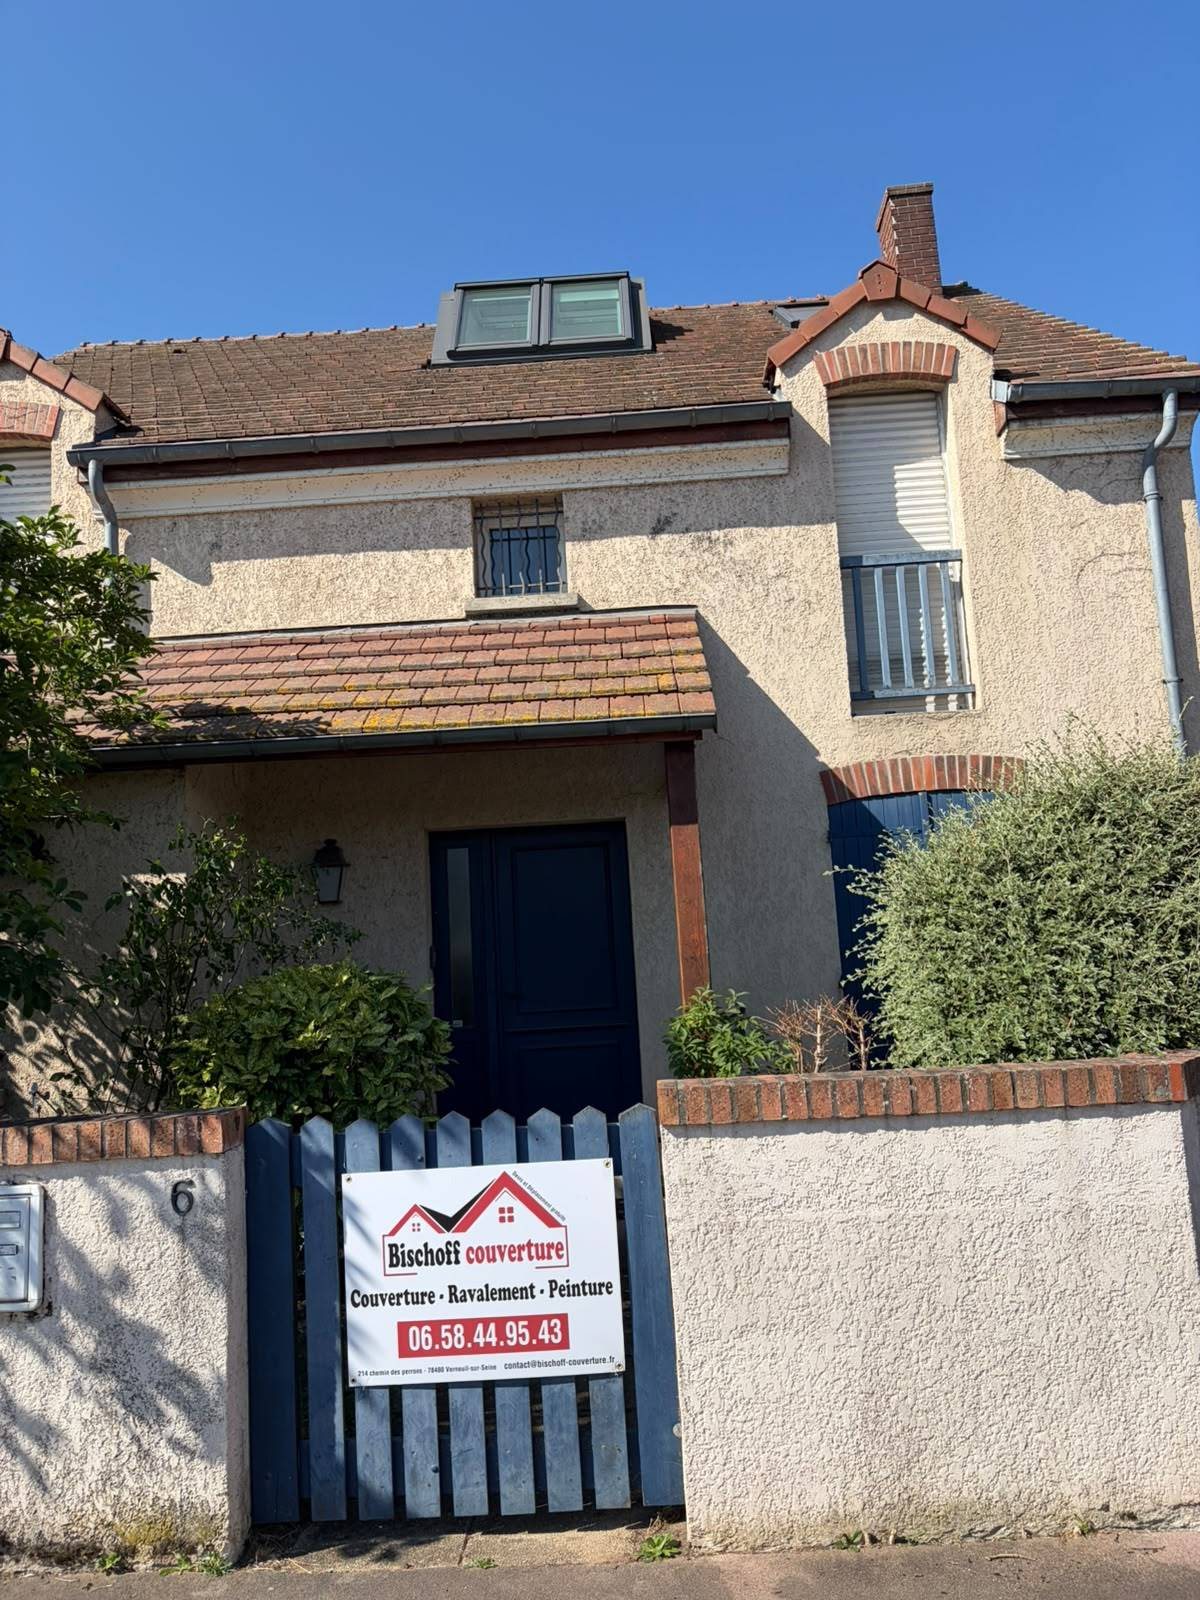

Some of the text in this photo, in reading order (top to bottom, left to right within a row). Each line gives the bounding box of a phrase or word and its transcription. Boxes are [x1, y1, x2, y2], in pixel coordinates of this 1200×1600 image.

[171, 1178, 196, 1216] 6
[388, 1239, 565, 1268] Bischoff couverture
[351, 1278, 613, 1308] Couverture Ravalement Peinture
[408, 1318, 563, 1352] 06.58.44.95.43
[446, 1364, 496, 1374] Verneuil-sur-Seine
[504, 1356, 616, 1370] contact@bischoff-couverture.fr
